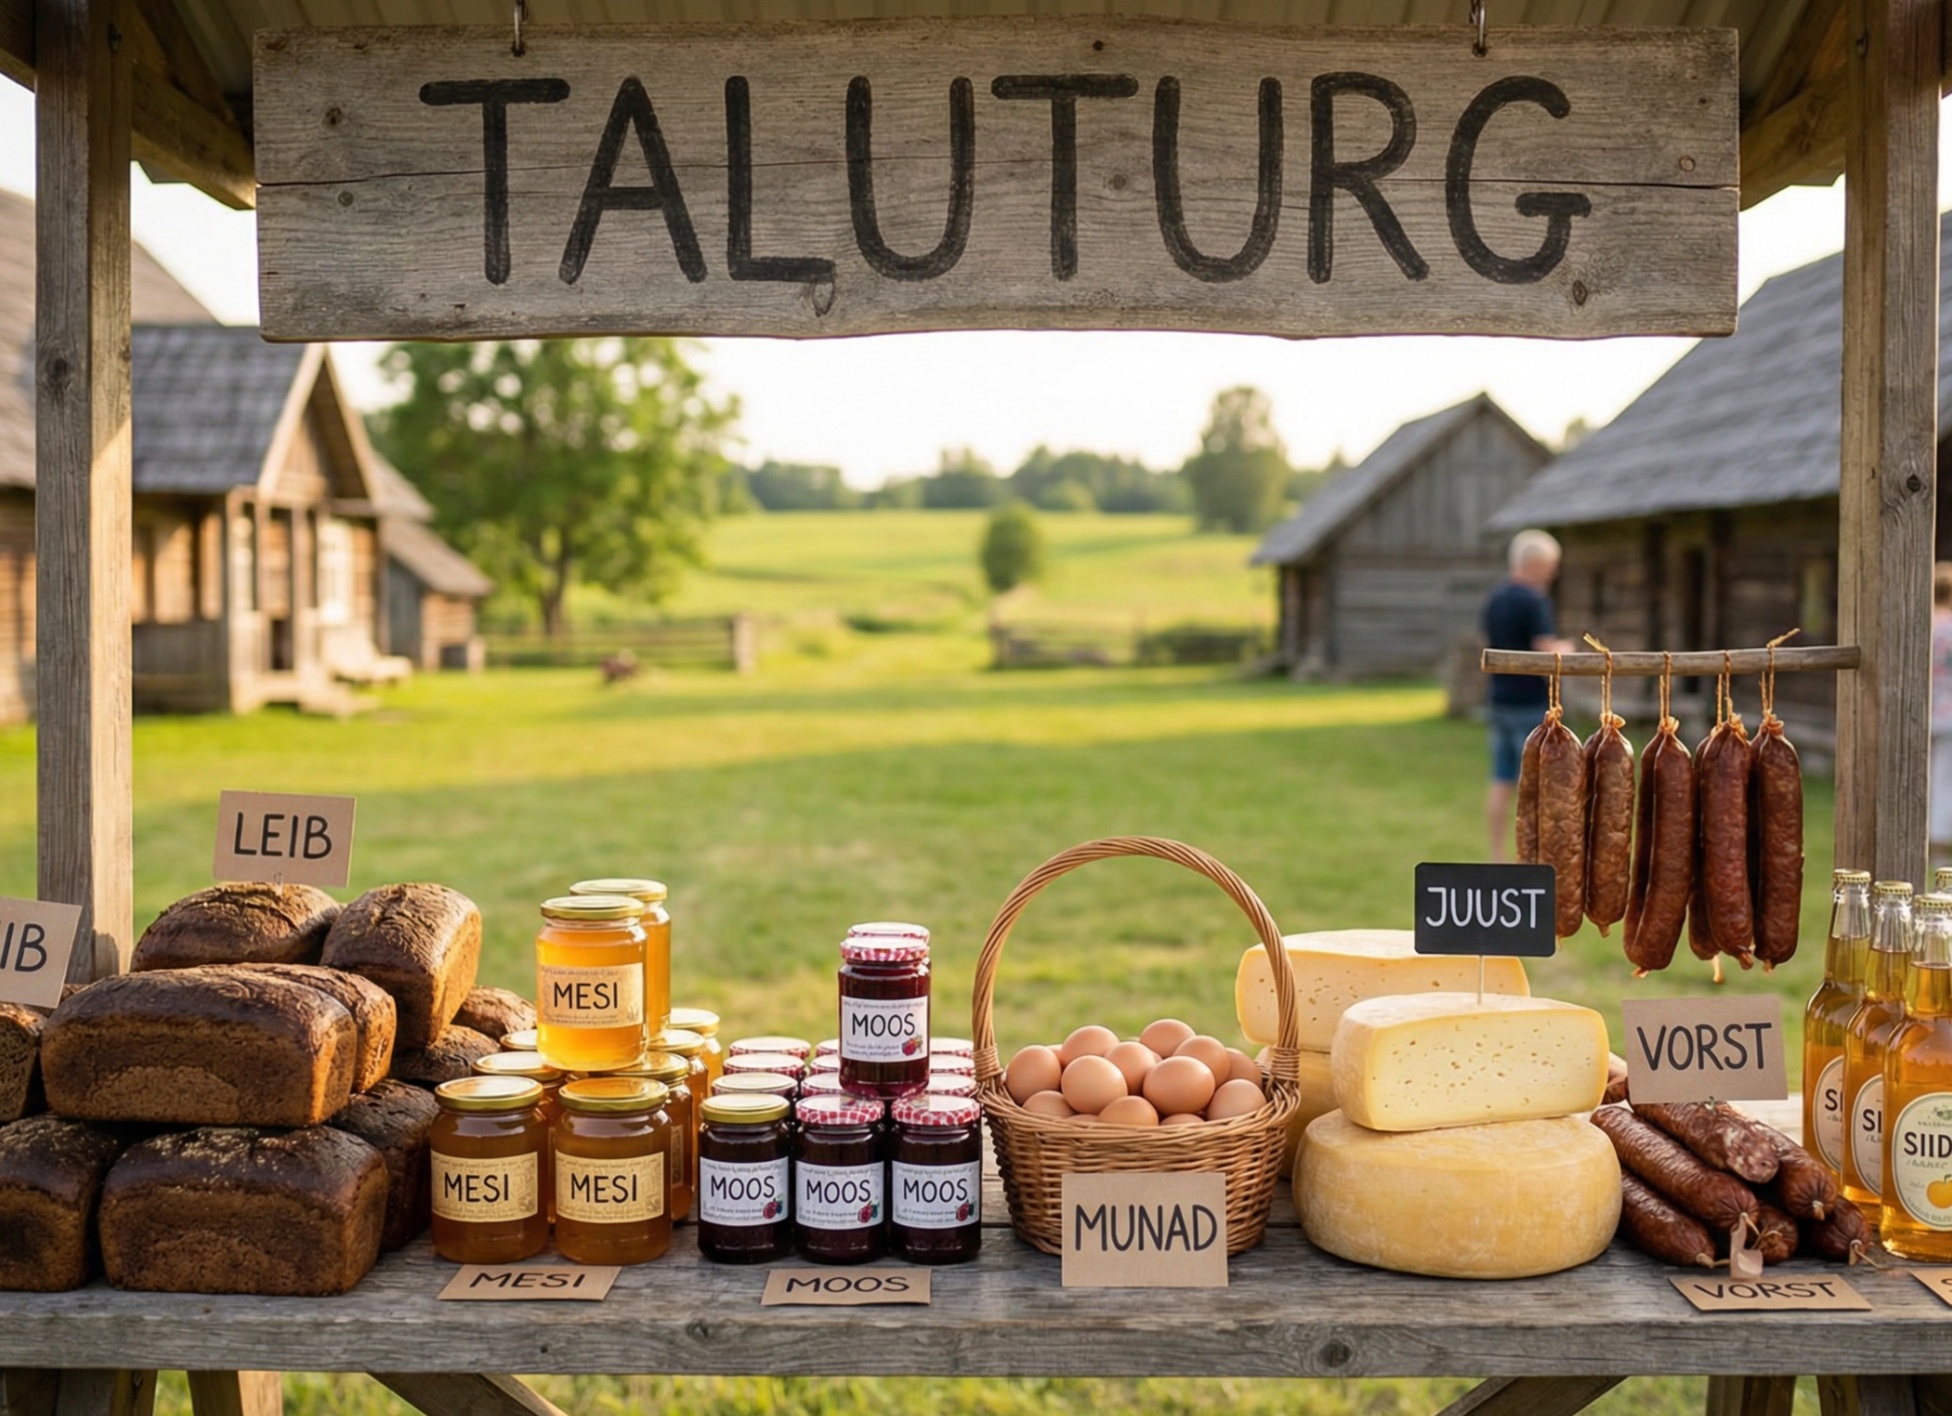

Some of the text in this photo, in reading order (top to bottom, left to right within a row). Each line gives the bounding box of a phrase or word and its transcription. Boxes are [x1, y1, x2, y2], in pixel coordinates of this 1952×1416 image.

[419, 72, 1593, 286] TALUTURG
[234, 811, 333, 860] LEIB
[1425, 886, 1547, 929] JUUST
[0, 921, 48, 973] IB
[553, 980, 619, 1011] MESI
[851, 1011, 916, 1038] MOOS
[1635, 1022, 1773, 1072] VORST
[444, 1171, 510, 1204] MESI
[571, 1172, 638, 1204] MESI
[710, 1174, 776, 1201] MOOS
[805, 1178, 872, 1205] MOOS
[902, 1177, 969, 1204] MOOS
[1074, 1204, 1219, 1253] MUNAD
[468, 1271, 587, 1289] MESI
[784, 1276, 911, 1293] MOOS
[1693, 1281, 1837, 1299] VORST
